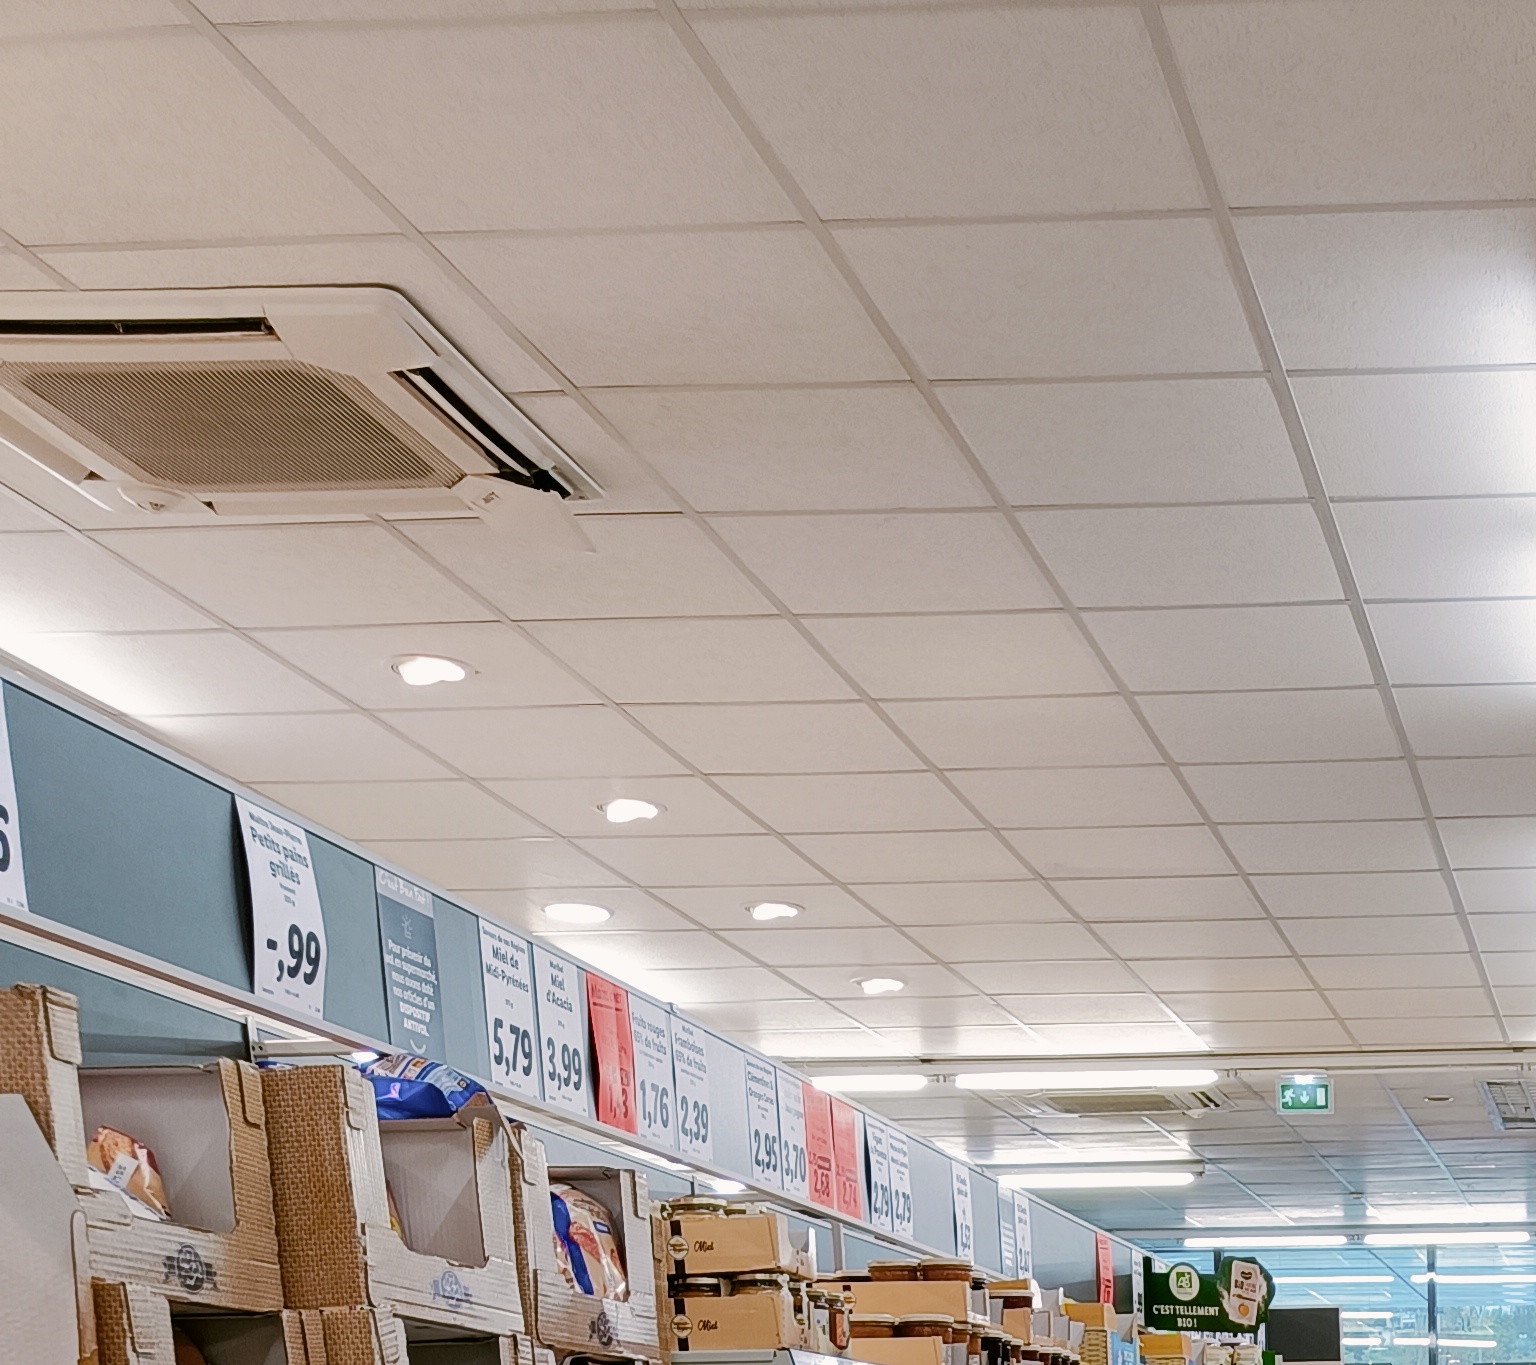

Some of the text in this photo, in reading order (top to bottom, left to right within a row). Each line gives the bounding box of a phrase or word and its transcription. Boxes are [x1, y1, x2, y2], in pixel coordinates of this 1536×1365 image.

[250, 826, 309, 869] Petits pains
[270, 860, 300, 885] grillés
[266, 923, 321, 985] -,99
[492, 945, 519, 971] Miel de
[486, 961, 529, 993] Midi-Pyrénées
[551, 973, 565, 992] Miel
[546, 990, 573, 1013] d'Acacia
[647, 1019, 666, 1039] rouges
[493, 1017, 533, 1077] 5,79
[547, 1036, 583, 1092] 3,99
[652, 1038, 667, 1056] fruits
[639, 1078, 669, 1129] 1,76
[680, 1095, 709, 1145] 2,39
[754, 1128, 778, 1174] 2,95
[873, 1180, 890, 1218] 2,79
[895, 1188, 912, 1225] 2,79
[1152, 1304, 1220, 1317] C'EST TELLEMENT
[1176, 1316, 1193, 1329] BIO
